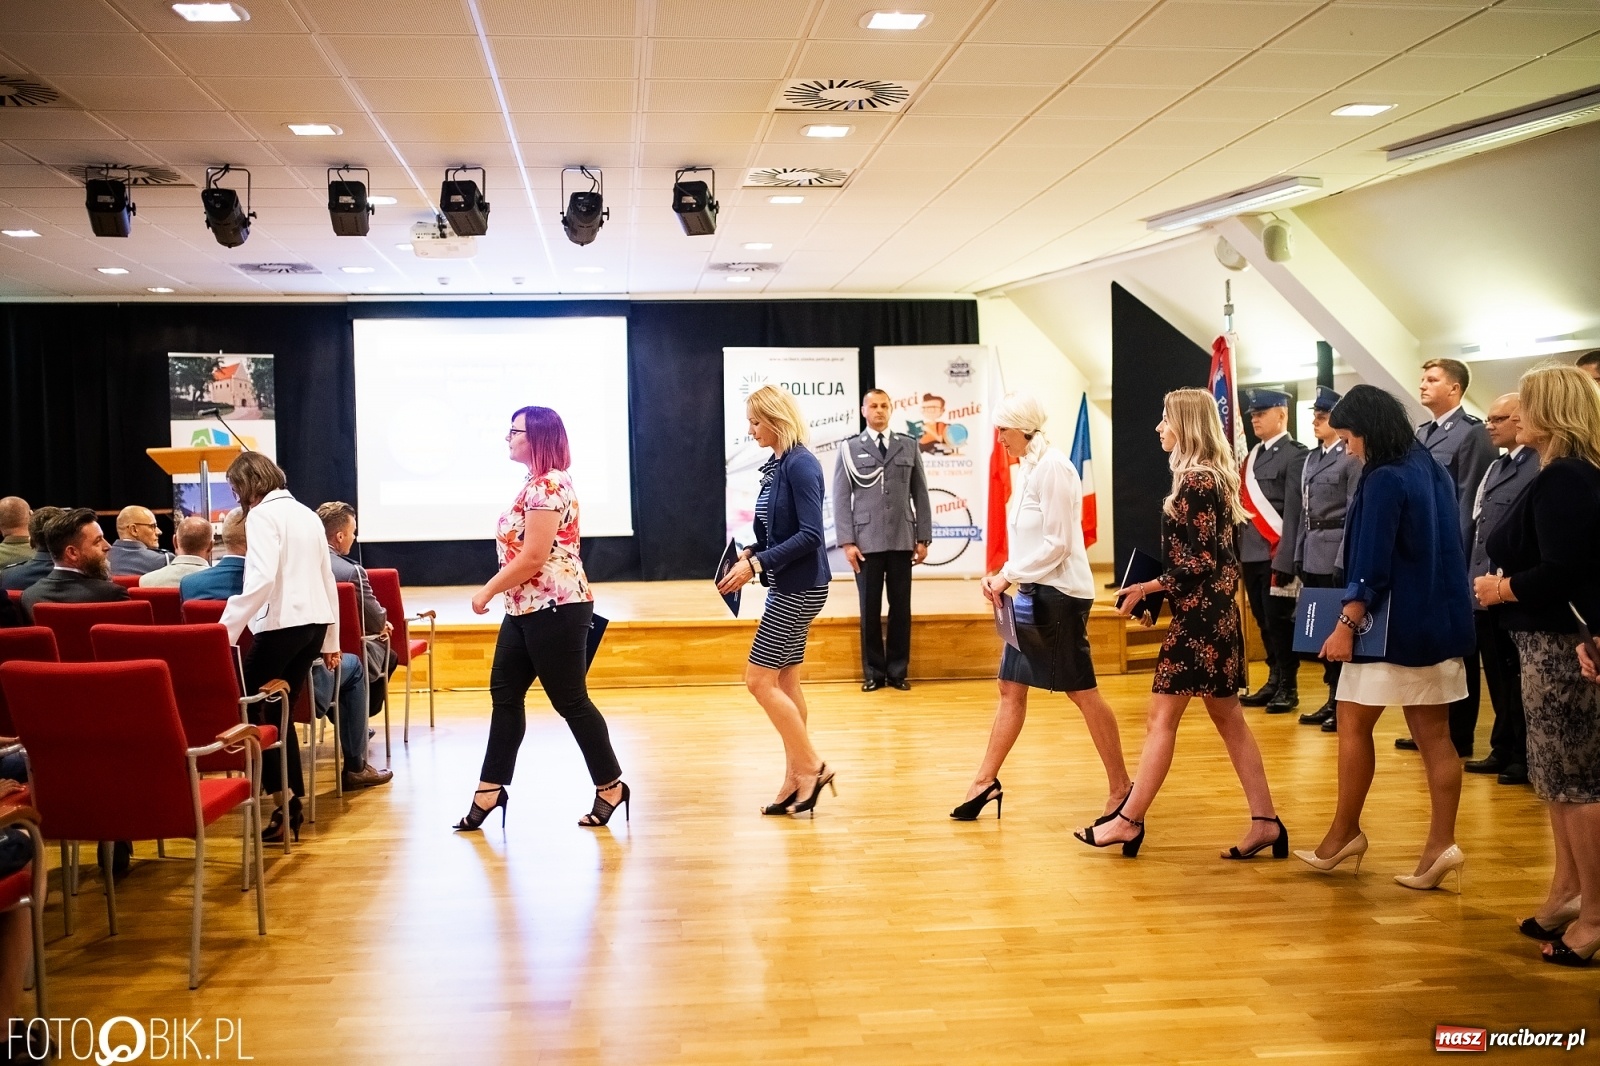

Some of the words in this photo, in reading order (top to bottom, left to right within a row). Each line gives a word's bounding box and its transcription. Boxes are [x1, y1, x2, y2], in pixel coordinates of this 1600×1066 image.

[780, 382, 845, 396] POLICJA
[894, 391, 918, 411] ręci
[948, 401, 982, 420] mnie
[809, 408, 855, 428] eczniej!
[936, 496, 967, 514] mnie
